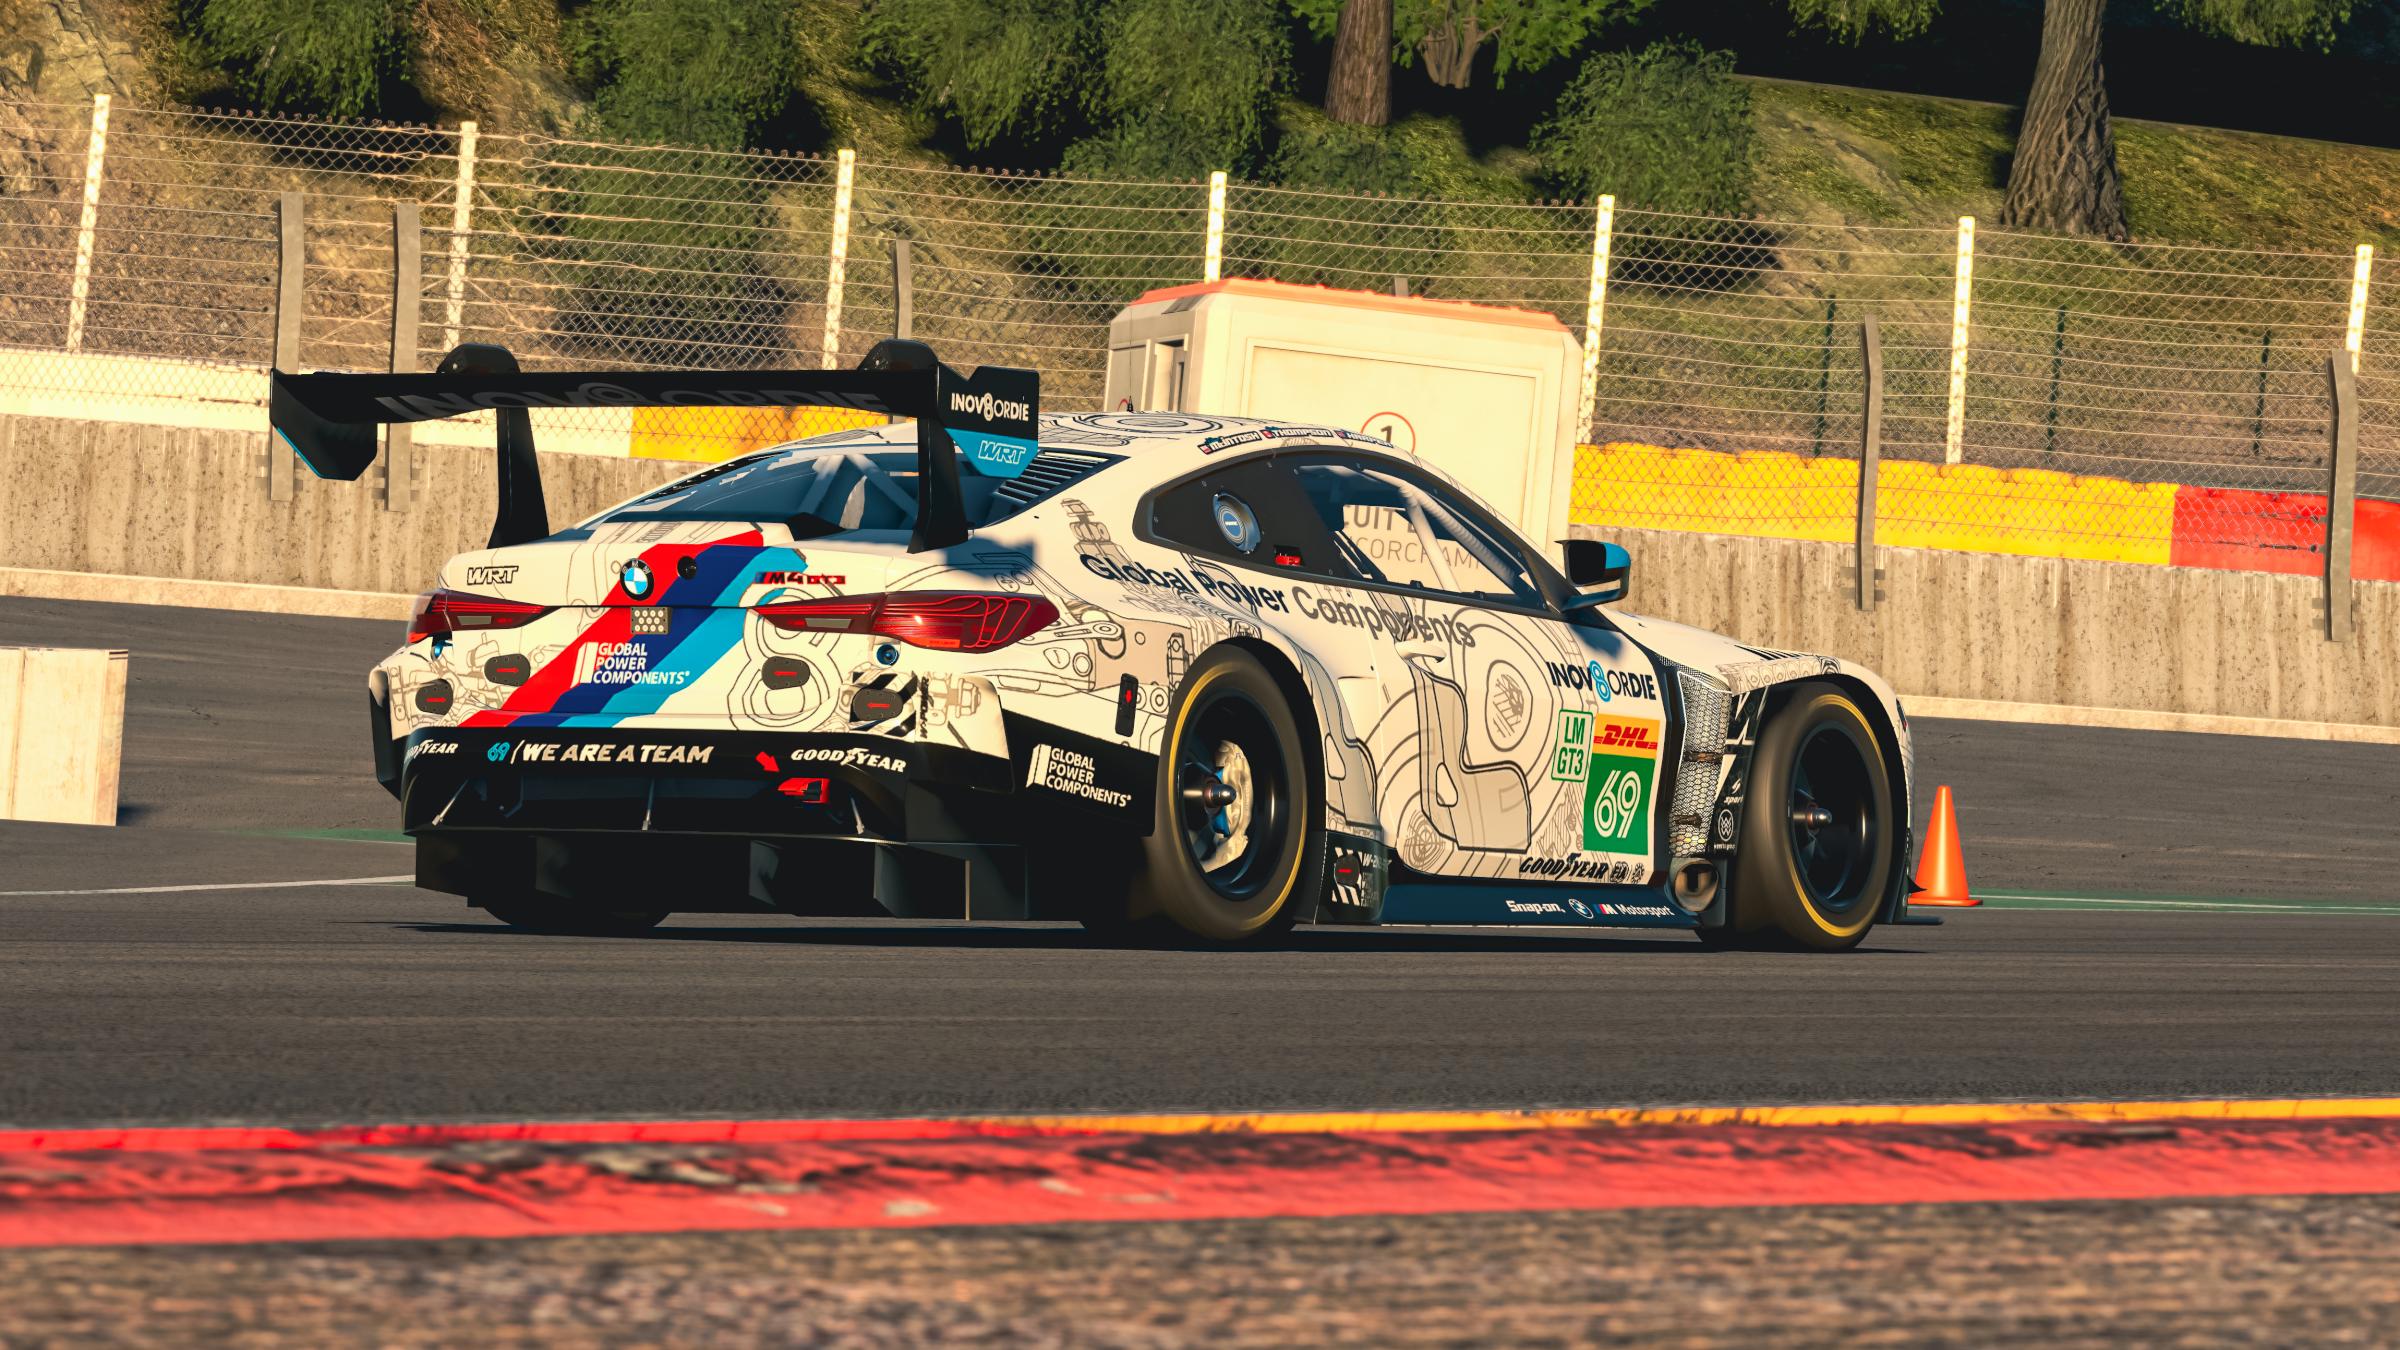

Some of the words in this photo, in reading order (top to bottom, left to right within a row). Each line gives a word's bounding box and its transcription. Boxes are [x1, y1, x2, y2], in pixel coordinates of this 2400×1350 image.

[951, 392, 1029, 421] INOV8ORDIE
[1380, 425, 1392, 443] 1
[978, 440, 1026, 464] WRT
[1343, 505, 1393, 531] UIT
[467, 565, 519, 586] WRT
[1079, 553, 1201, 594] Global
[1190, 569, 1290, 614] Power
[1291, 585, 1475, 648] Components
[599, 642, 647, 656] GLOBAL
[596, 656, 647, 670] POWER
[1546, 660, 1656, 702] INOV8ORDIE
[1564, 715, 1585, 745] LM
[1600, 724, 1655, 749] DHL
[487, 742, 511, 762] 69
[522, 743, 561, 761] WE
[560, 744, 617, 762] ARE
[616, 744, 635, 762] A
[640, 744, 714, 764] TEAM
[791, 747, 907, 773] GOODYEAR
[1051, 748, 1095, 771] GLOBAL
[1557, 749, 1584, 776] GT3
[1048, 761, 1094, 784] POWER
[1594, 770, 1641, 838] 69
[1519, 852, 1609, 880] GOODYEAR
[1615, 904, 1675, 917] Motorsport
